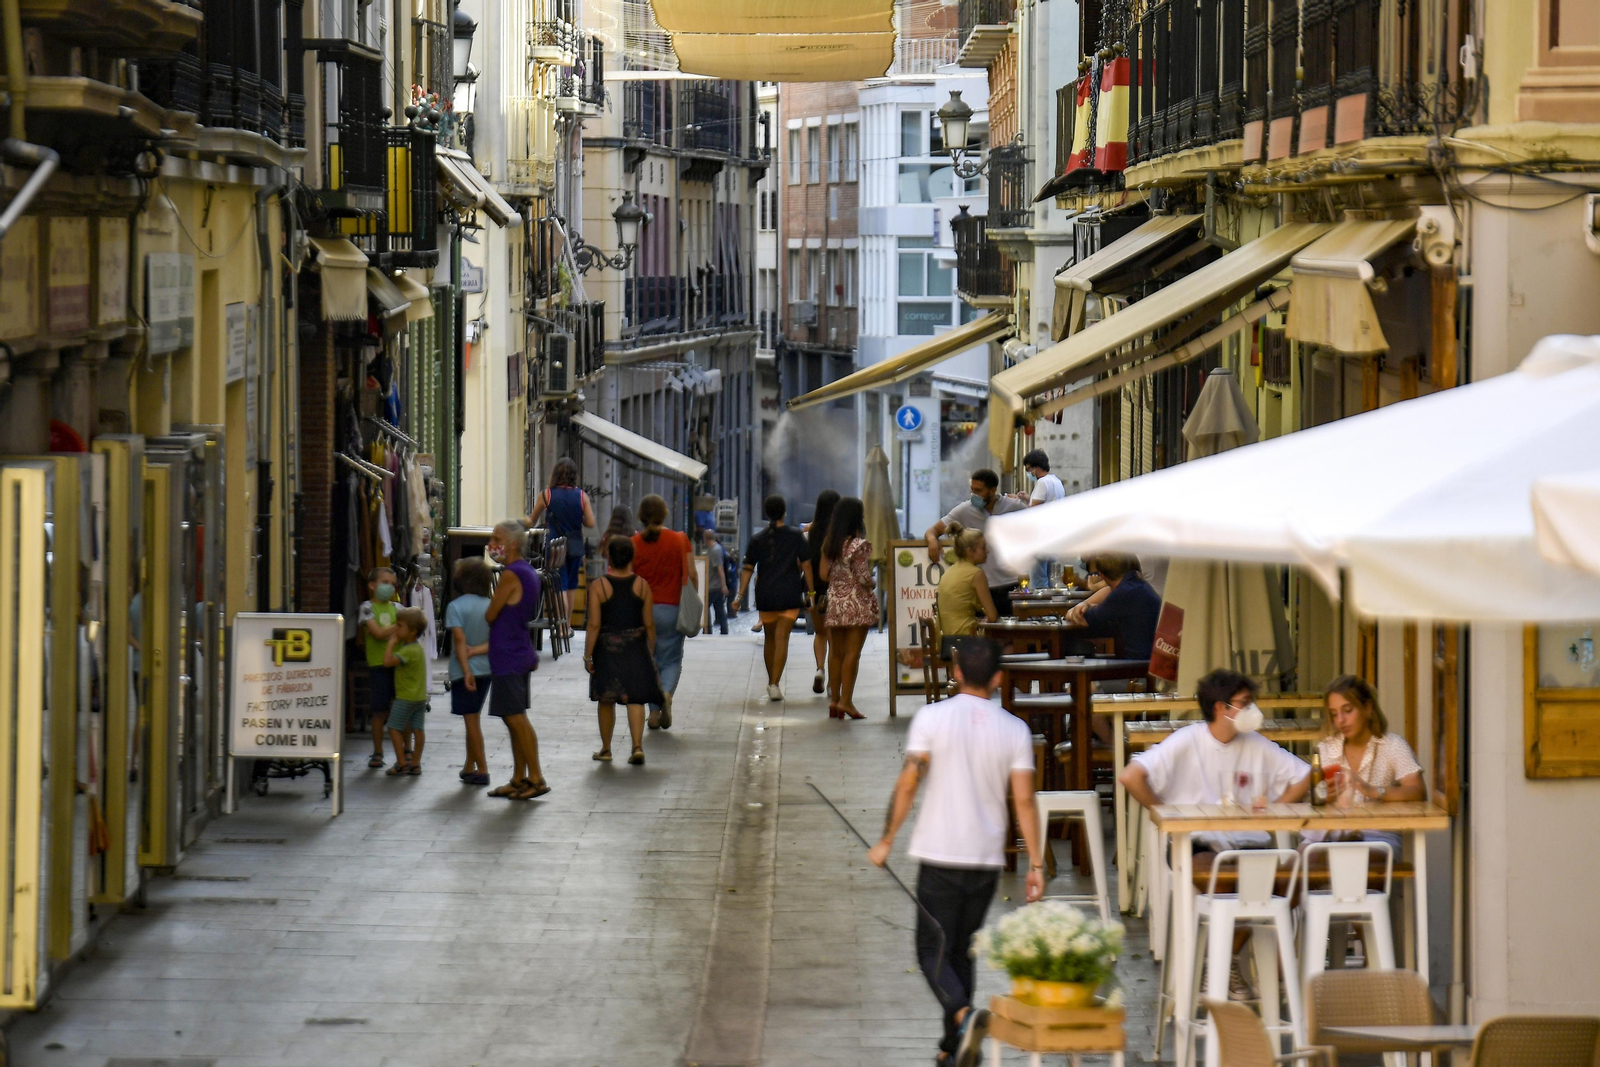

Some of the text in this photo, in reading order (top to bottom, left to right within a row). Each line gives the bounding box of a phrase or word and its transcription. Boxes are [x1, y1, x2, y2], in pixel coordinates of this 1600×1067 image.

[904, 312, 946, 320] corresur
[913, 562, 945, 587] 10
[264, 629, 312, 667] TB
[243, 667, 332, 683] PRECIOS DIRECTOS
[261, 685, 274, 695] DE
[246, 695, 329, 713] FACTORY PRICE
[242, 718, 331, 729] PASEN Y VEAN
[255, 734, 317, 746] COME IN
